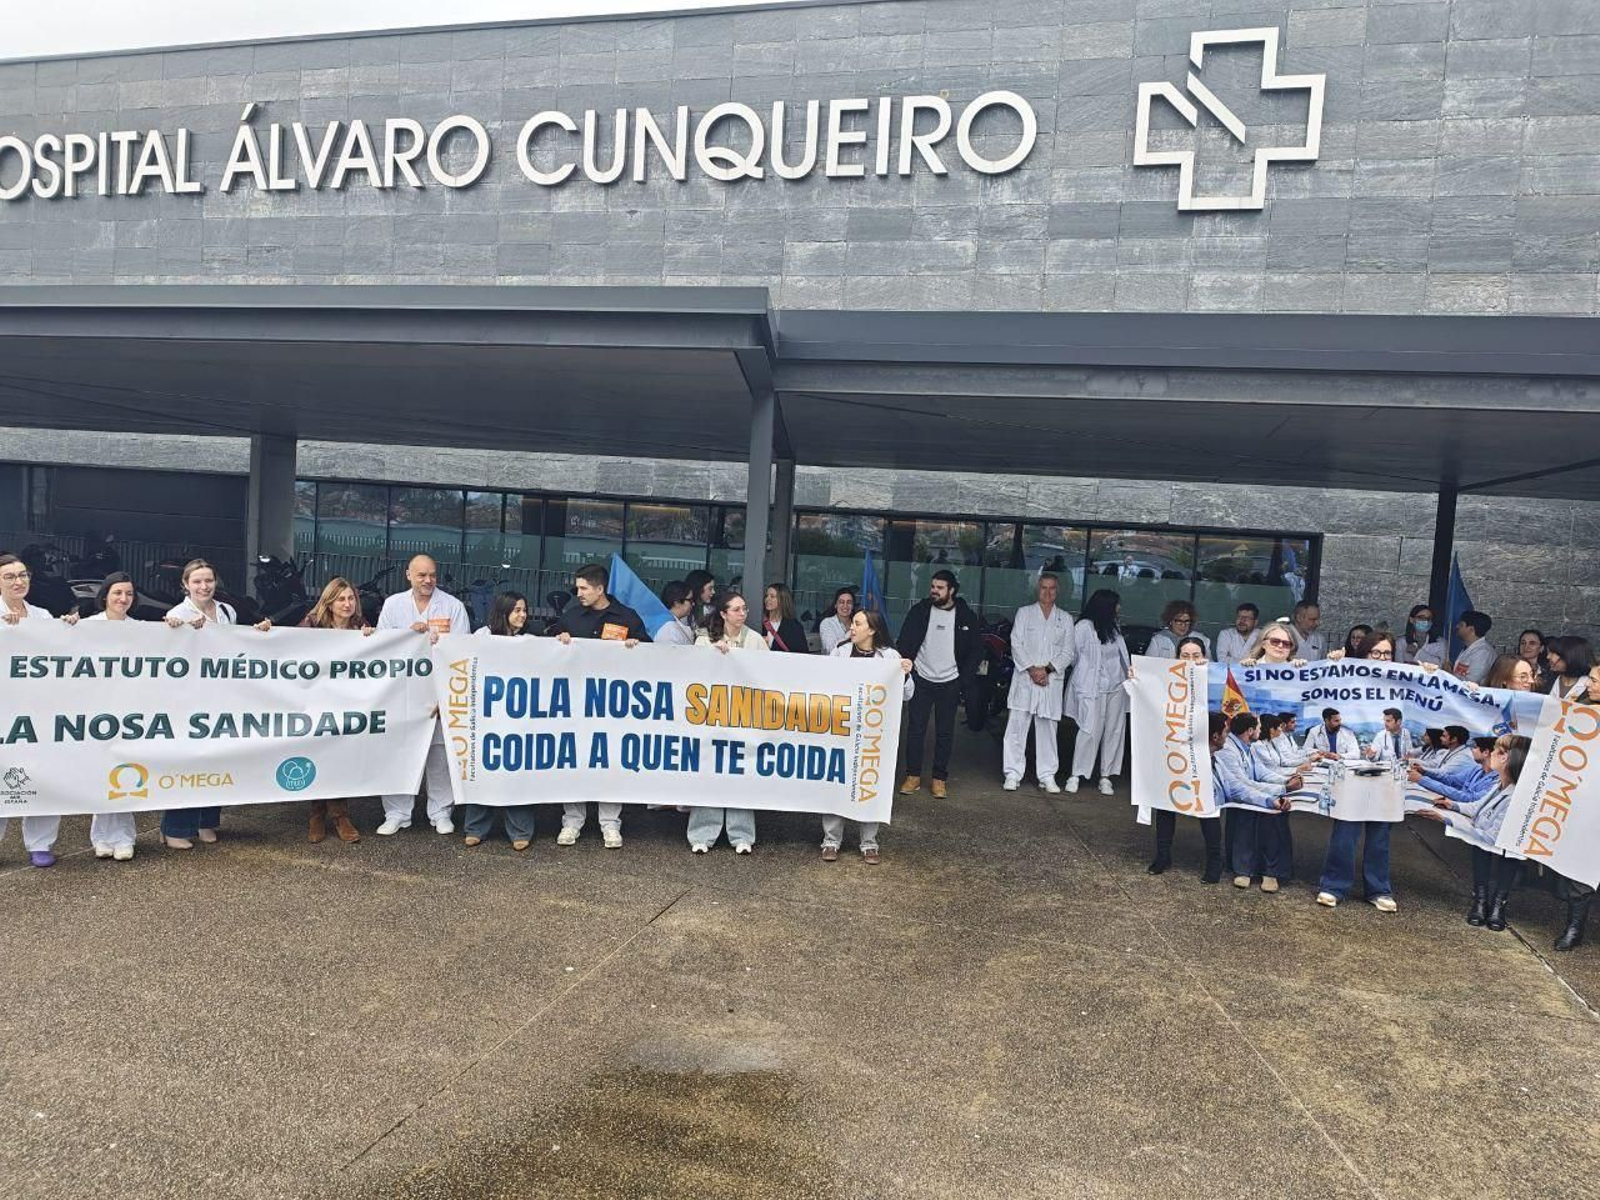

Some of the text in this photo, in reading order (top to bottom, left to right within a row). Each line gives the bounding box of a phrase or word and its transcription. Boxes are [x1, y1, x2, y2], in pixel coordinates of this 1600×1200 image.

[0, 90, 1038, 200] OSPITAL ÁLVARO CUNQUEIRO
[9, 652, 433, 681] ESTATUTO MÉDICO PROPIO
[1244, 669, 1261, 682] SI
[1265, 669, 1295, 681] NO
[1300, 664, 1382, 682] ESTAMOS
[1386, 669, 1413, 682] EN
[1419, 673, 1441, 690] LA
[483, 675, 852, 736] POLA NOSA SANIDADE
[1301, 687, 1444, 712] SOMOS EL MENÚ
[0, 709, 387, 745] A NOSA SANIDADE
[481, 731, 847, 785] COIDA A QUEN TE COIDA
